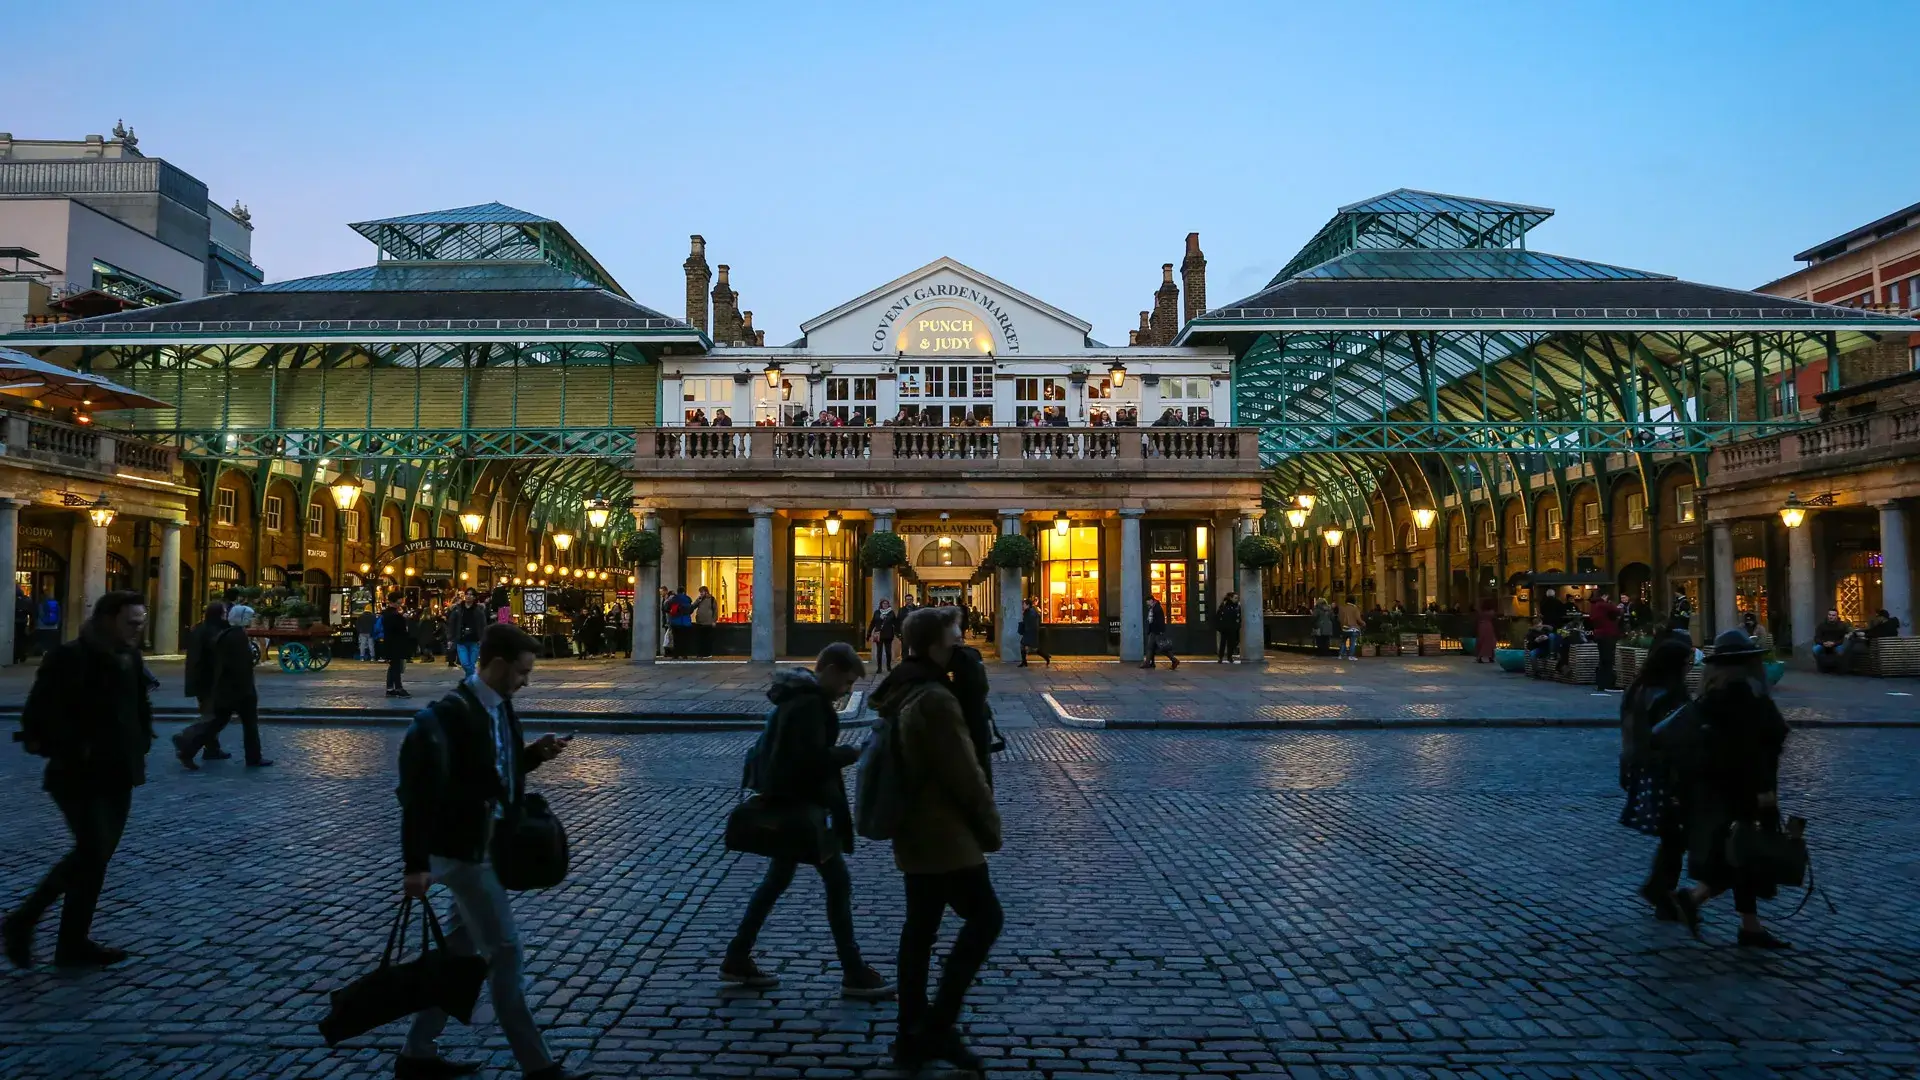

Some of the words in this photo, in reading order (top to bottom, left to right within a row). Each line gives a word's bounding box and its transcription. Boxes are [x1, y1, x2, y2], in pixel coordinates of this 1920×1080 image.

[872, 295, 911, 352] COVENT
[914, 284, 980, 302] GARDEN
[979, 296, 1019, 353] MARKET
[919, 320, 973, 332] PUNCH
[919, 338, 931, 350] &
[933, 337, 973, 352] JUDY
[18, 525, 53, 538] GODIVA
[901, 524, 949, 533] CENTRAL
[950, 524, 993, 533] AVENUE
[404, 540, 431, 552] APPLE
[435, 539, 476, 552] MARKET
[604, 567, 633, 576] MARKET
